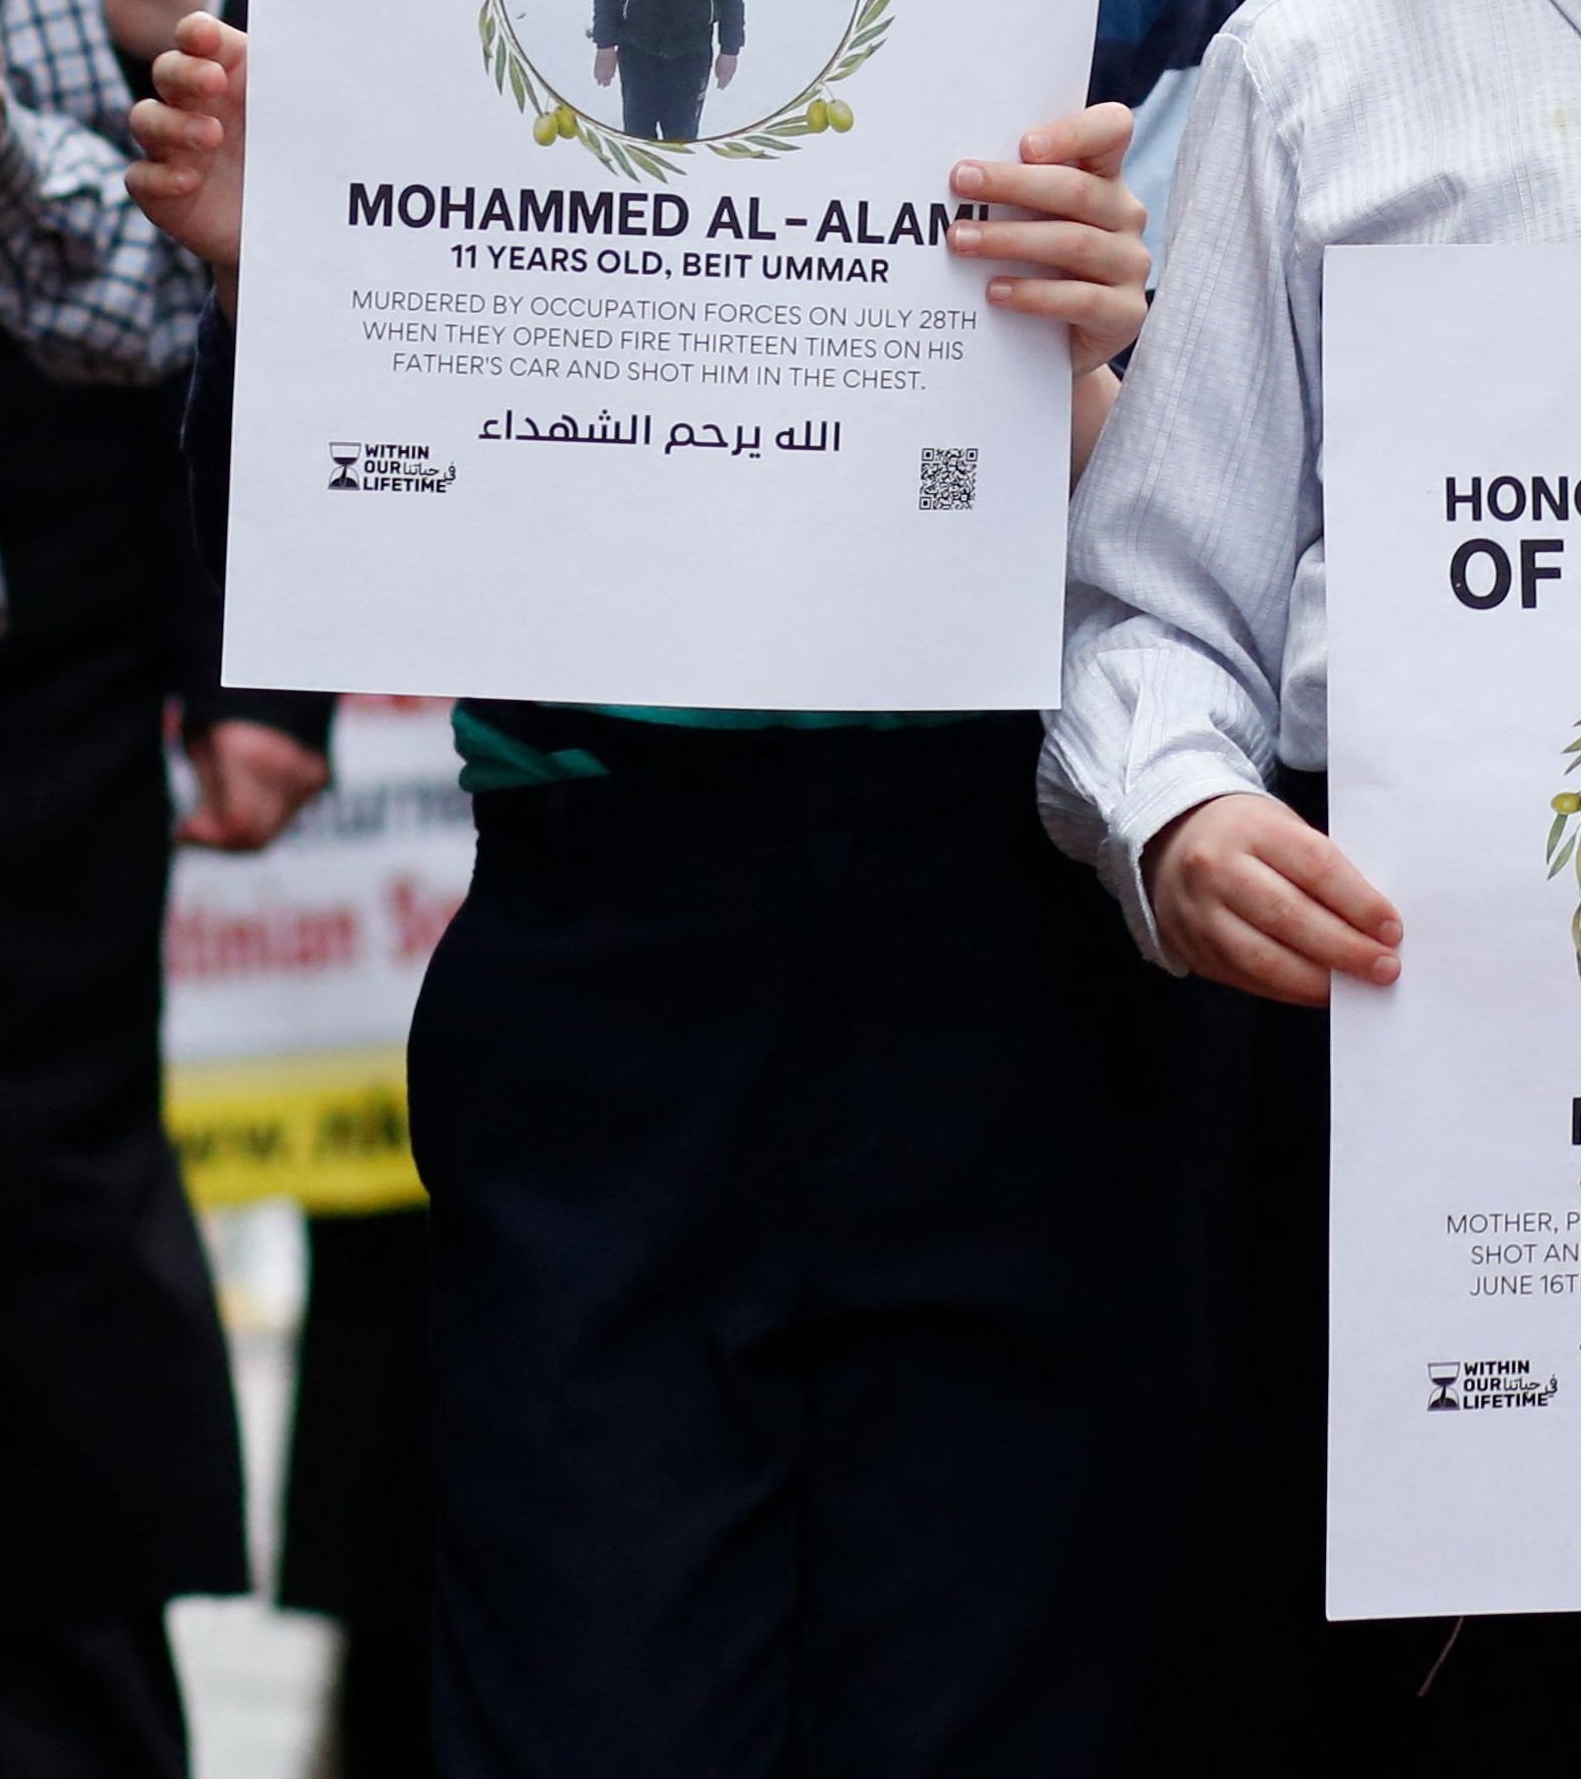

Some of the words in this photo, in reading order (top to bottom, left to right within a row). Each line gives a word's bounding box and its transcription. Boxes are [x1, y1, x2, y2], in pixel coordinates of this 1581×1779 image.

[348, 182, 690, 237] MOHAMMED
[450, 244, 477, 269] 11
[487, 245, 588, 273] YEARS
[596, 249, 672, 280] OLD,
[682, 252, 753, 279] BEIT
[762, 254, 889, 284] UMMAR
[352, 289, 486, 314] MURDERED
[493, 294, 524, 315] BY
[530, 296, 696, 322] OCCUPATION
[704, 302, 802, 326] FORCES
[808, 306, 847, 327] ON
[854, 308, 913, 329] JULY
[919, 309, 977, 330] 28TH
[362, 321, 437, 343] WHEN
[444, 323, 507, 345] THEY
[512, 326, 613, 349] OPENED
[620, 330, 671, 352] FIRE
[678, 332, 797, 356] THIRTEEN
[804, 336, 877, 359] TIMES
[883, 339, 921, 360] ON
[928, 340, 964, 361] HIS
[393, 352, 503, 376] FATHER'S
[509, 357, 560, 378] CAR
[565, 359, 621, 380] AND
[627, 361, 695, 383] SHOT
[701, 364, 749, 385] HIM
[757, 366, 781, 386] IN
[788, 366, 836, 388] THE
[842, 368, 926, 391] CHEST.
[478, 409, 651, 445] الشهداء
[664, 422, 761, 459] يرحم
[775, 420, 841, 452] الله
[365, 444, 430, 460] WITHIN
[364, 460, 400, 474] OUR
[363, 477, 446, 493] LIFETIME
[1449, 537, 1565, 611] OF
[1446, 1212, 1559, 1235] MOTHER,
[1471, 1243, 1538, 1266] SHOT
[1469, 1274, 1533, 1297] JUNE
[1464, 1360, 1530, 1375] WITHIN
[1464, 1378, 1501, 1392] OUR
[1463, 1393, 1549, 1409] LIFETIME
